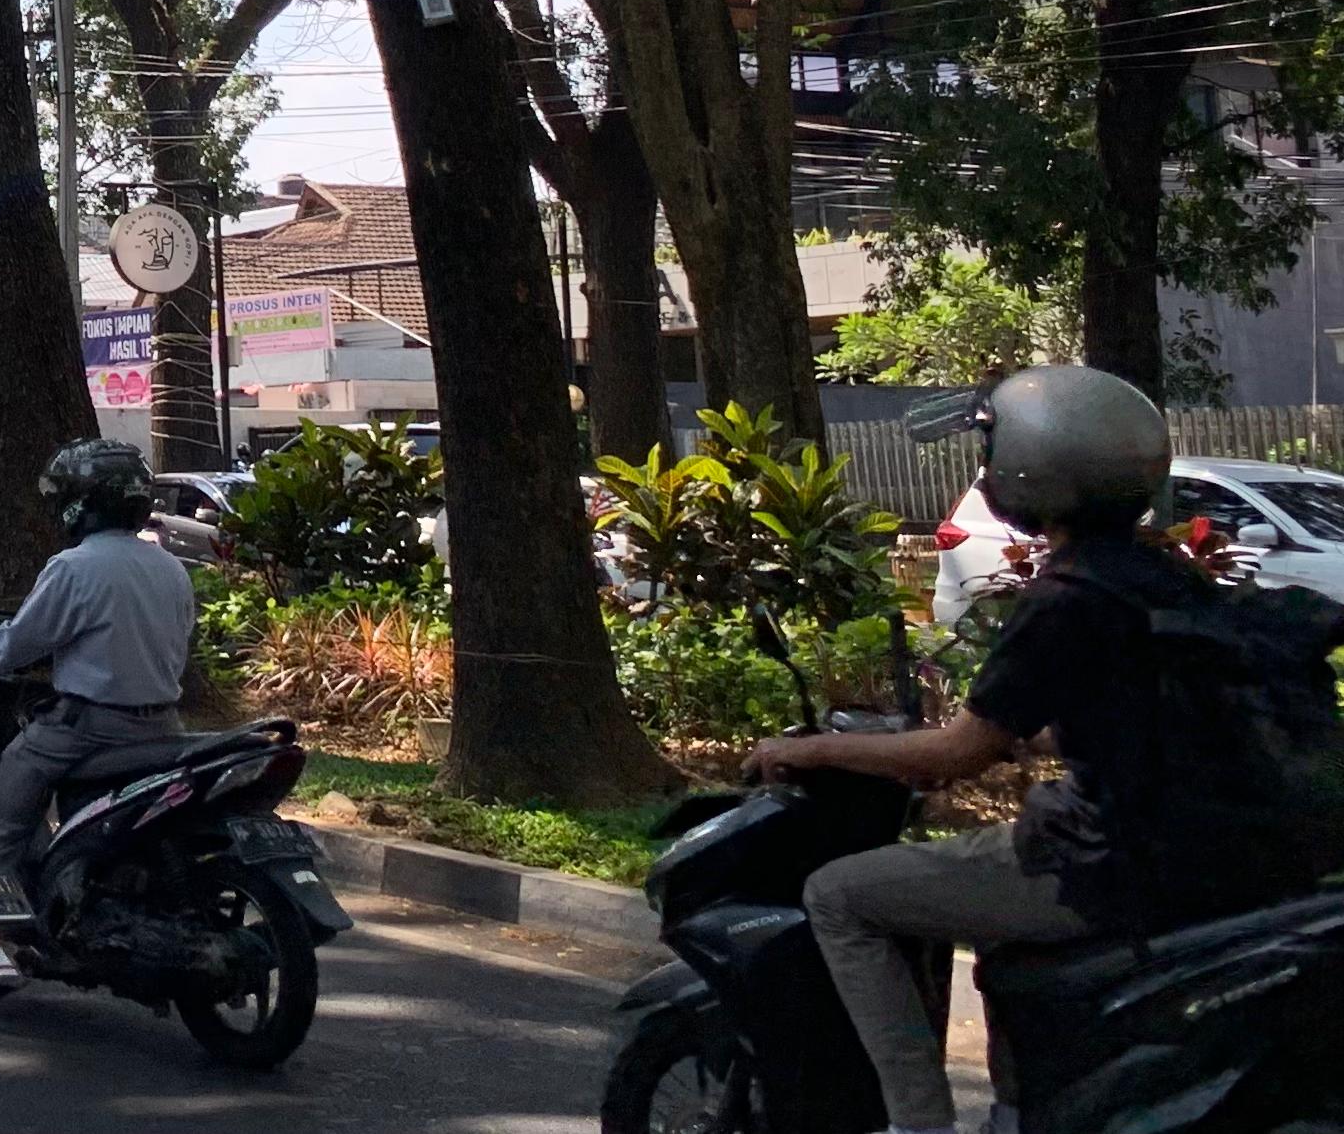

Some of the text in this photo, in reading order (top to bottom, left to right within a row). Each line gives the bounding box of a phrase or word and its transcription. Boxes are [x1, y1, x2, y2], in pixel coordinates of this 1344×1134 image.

[229, 297, 279, 315] PROSUS
[283, 293, 322, 307] INTEN
[83, 313, 151, 339] FOKUS IMPIAN
[109, 340, 139, 361] HASIL
